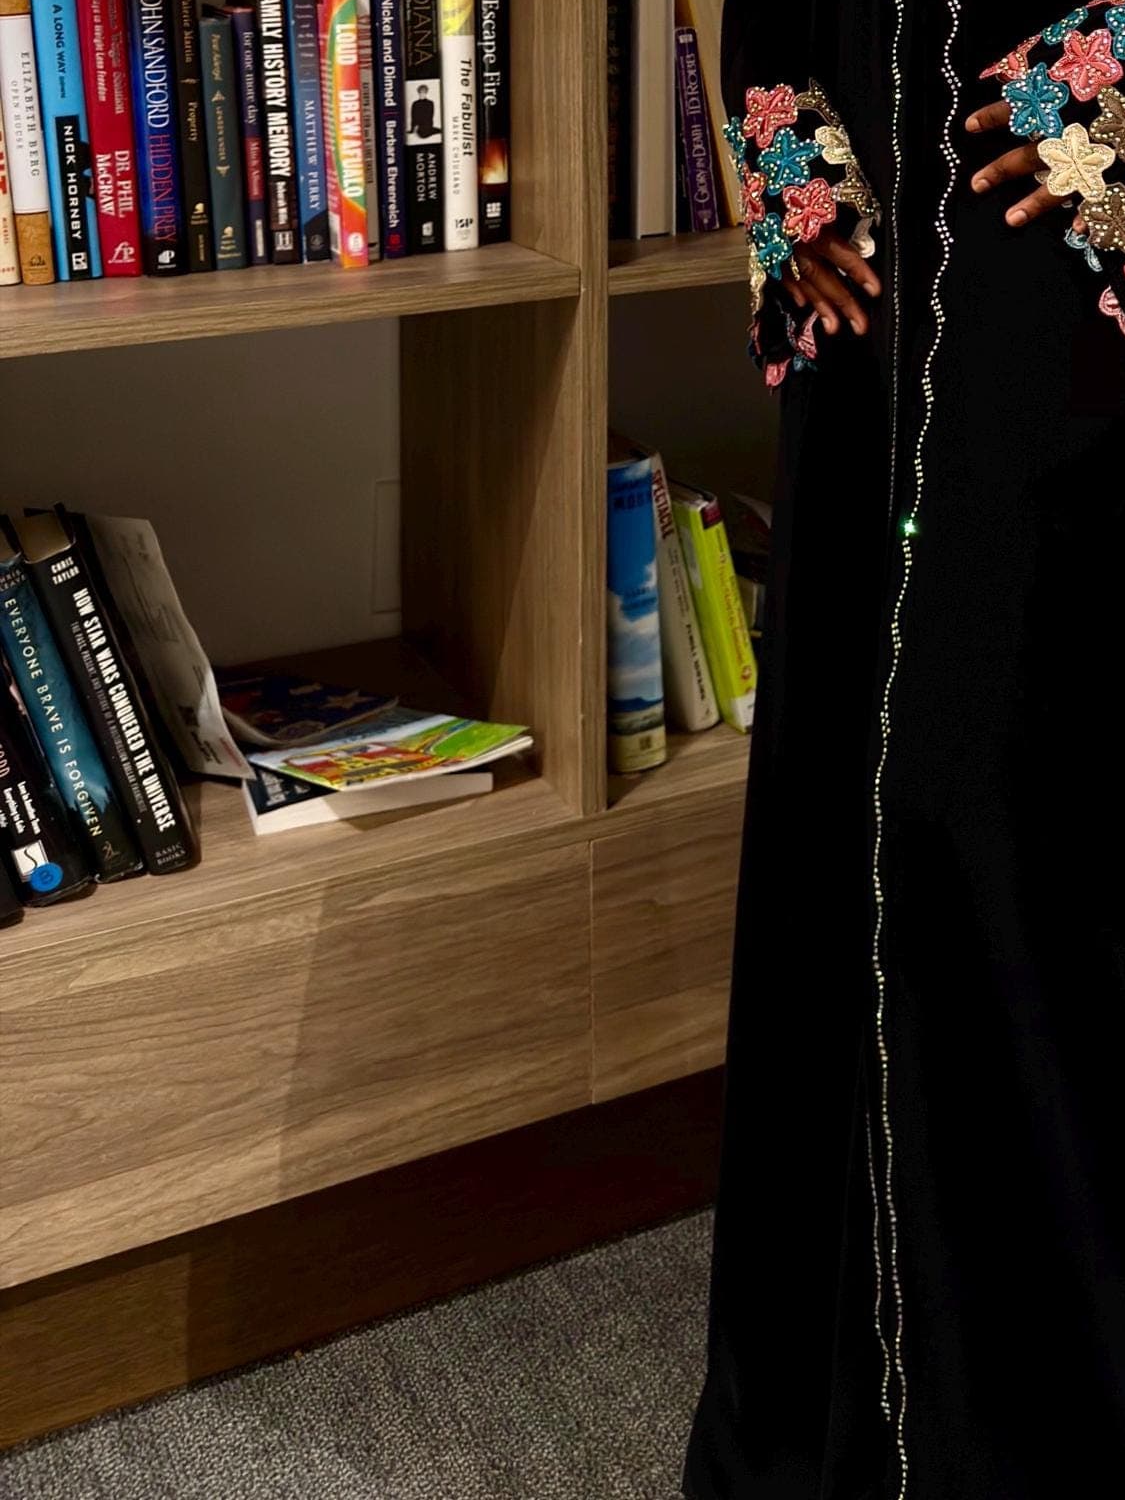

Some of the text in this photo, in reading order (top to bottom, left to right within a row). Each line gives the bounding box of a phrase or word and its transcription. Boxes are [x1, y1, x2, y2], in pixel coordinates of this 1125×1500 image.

[52, 4, 63, 14] A
[53, 17, 66, 49] LONG
[476, 0, 501, 64] Escape
[55, 51, 67, 76] WAY
[184, 30, 196, 63] Martin
[262, 44, 287, 107] HISTORY
[384, 39, 397, 63] and
[143, 39, 171, 128] SANDFORD
[243, 31, 258, 125] for one more day
[384, 66, 399, 107] Dimed
[460, 58, 475, 157] The Fabulist
[482, 70, 502, 107] Fire
[11, 80, 24, 150] OPEN HOUSE
[21, 52, 41, 177] ELIZABETH BERG
[187, 101, 200, 143] Property
[304, 99, 319, 165] MATTHEW
[335, 23, 364, 198] LOUD DREW AFUALO
[266, 112, 291, 177] MEMORY
[385, 120, 402, 229] Barbara Ehrenreich
[63, 125, 82, 240] NICK HORNBY
[95, 152, 116, 216] McGRAW
[114, 149, 134, 217] DR. PHIL
[150, 134, 177, 244] HIDDEN PREY
[307, 171, 320, 211] PERRY
[415, 153, 427, 202] MORTON
[426, 152, 438, 200] ANDREW
[652, 469, 675, 540] SPECTACLE
[51, 556, 75, 574] CHRIS
[52, 565, 80, 585] TAYLOR
[72, 587, 96, 617] HOW
[83, 615, 107, 650] STAR
[95, 647, 119, 685] WARS
[4, 598, 43, 680] EVERYONE
[36, 684, 64, 733] BRAVE
[56, 738, 72, 754] IS
[65, 759, 103, 838] FORGIVEN
[107, 682, 145, 756] CONQUERED
[133, 751, 153, 778] THE
[141, 773, 177, 833] UNIVERSE
